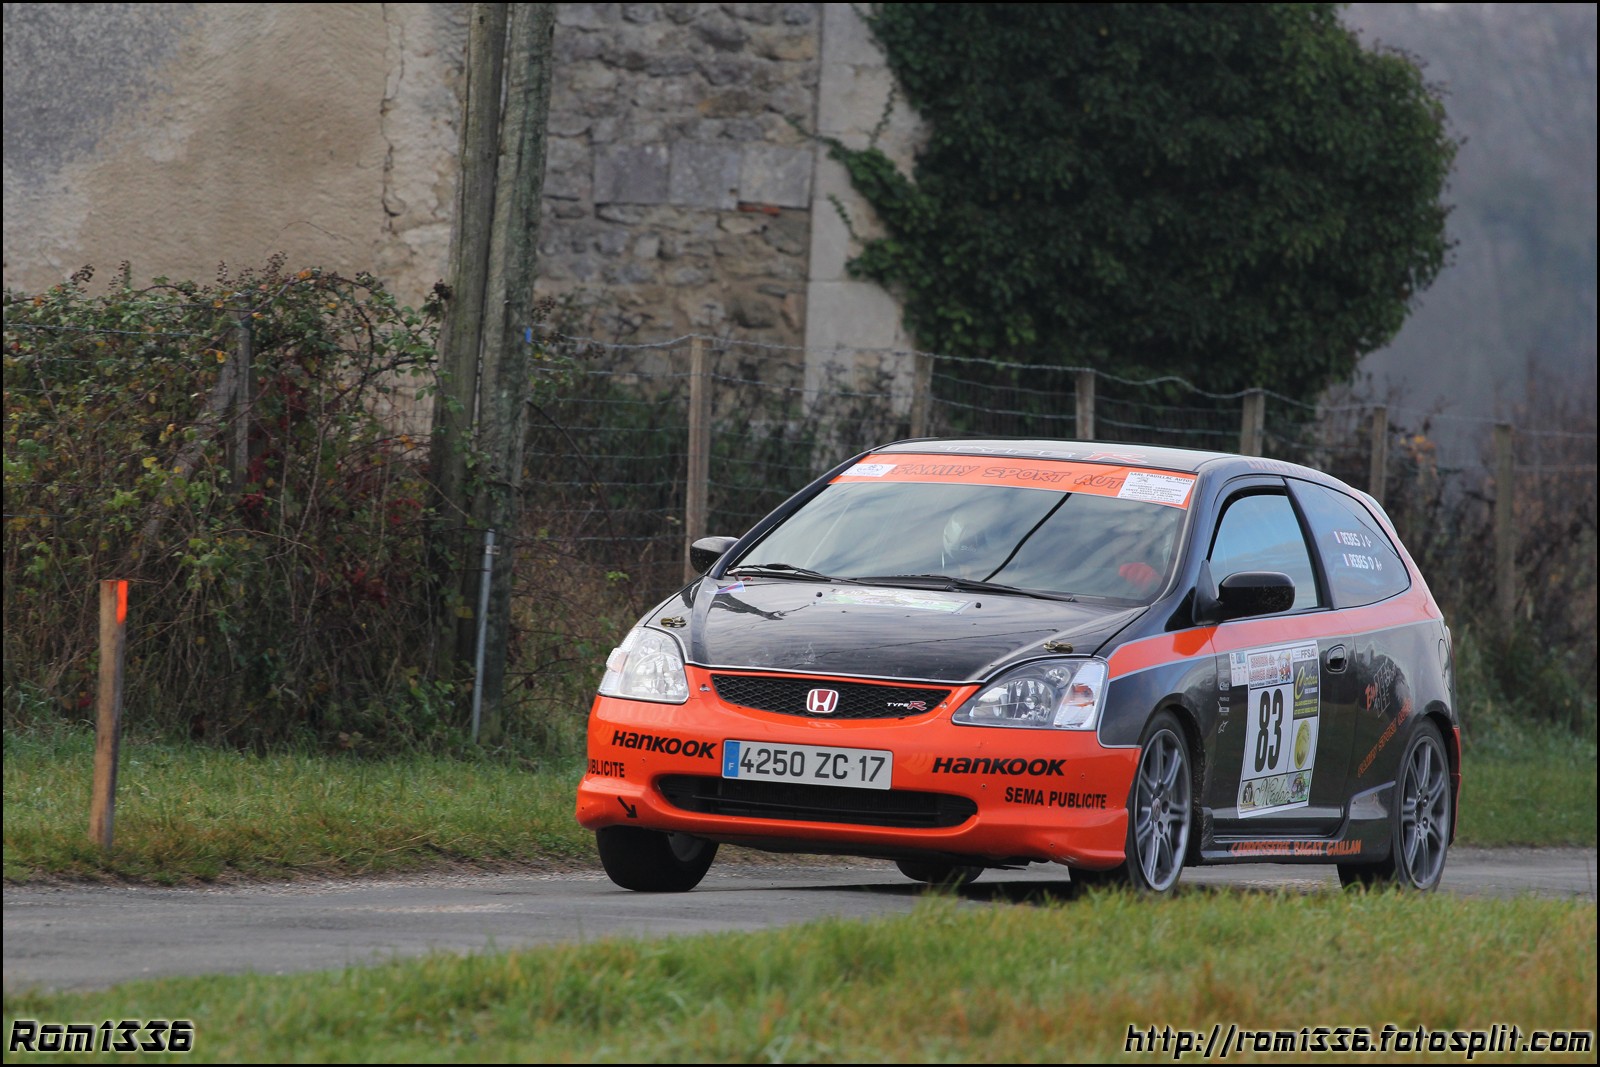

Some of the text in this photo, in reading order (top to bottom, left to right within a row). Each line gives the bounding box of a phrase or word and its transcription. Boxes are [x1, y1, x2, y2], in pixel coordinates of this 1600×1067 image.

[890, 464, 982, 478] FAMILY
[980, 466, 1072, 484] SPORT
[1073, 473, 1126, 490] AUT
[1300, 647, 1315, 659] FFSA
[907, 700, 928, 711] R
[1255, 688, 1284, 773] 83
[728, 747, 886, 783] F 4250 ZC 17
[1004, 786, 1107, 810] SEMA PUBLICITE
